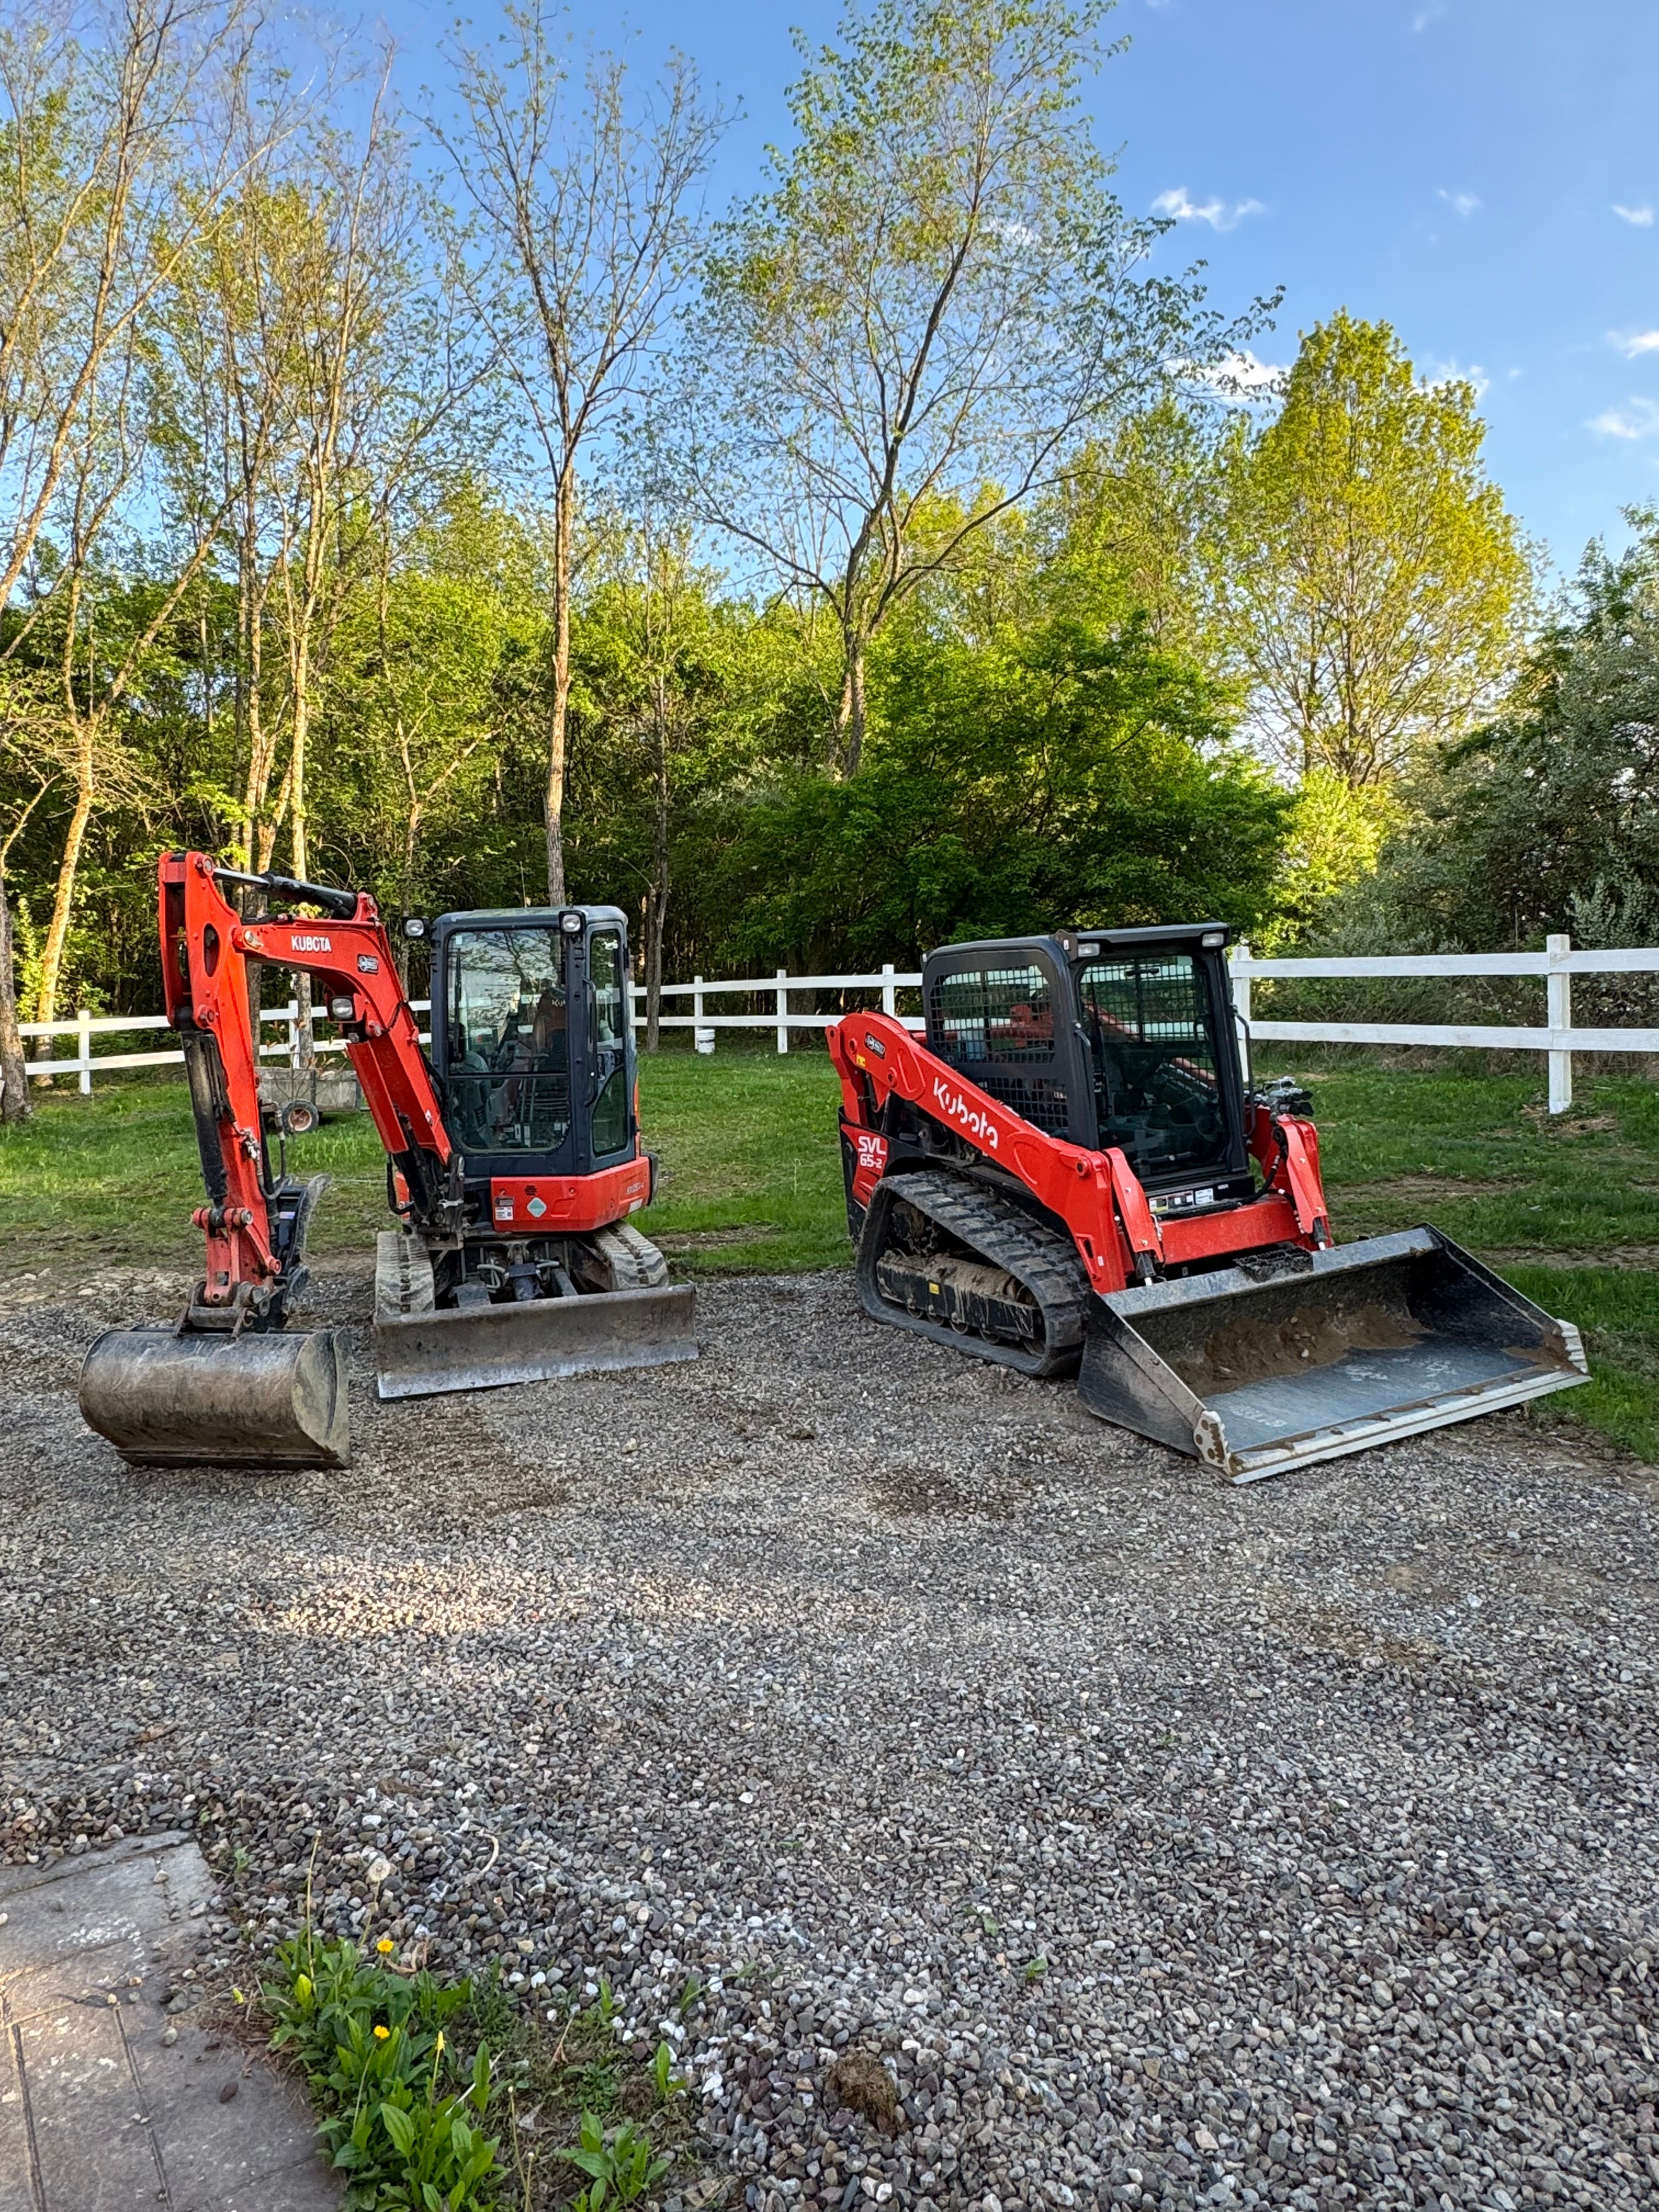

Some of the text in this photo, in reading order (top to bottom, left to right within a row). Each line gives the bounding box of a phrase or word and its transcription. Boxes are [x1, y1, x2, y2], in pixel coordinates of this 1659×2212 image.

[291, 935, 332, 952] KUBOTA
[933, 1076, 998, 1149] Kubota
[858, 1136, 887, 1155] SVL
[860, 1153, 882, 1169] 65-2
